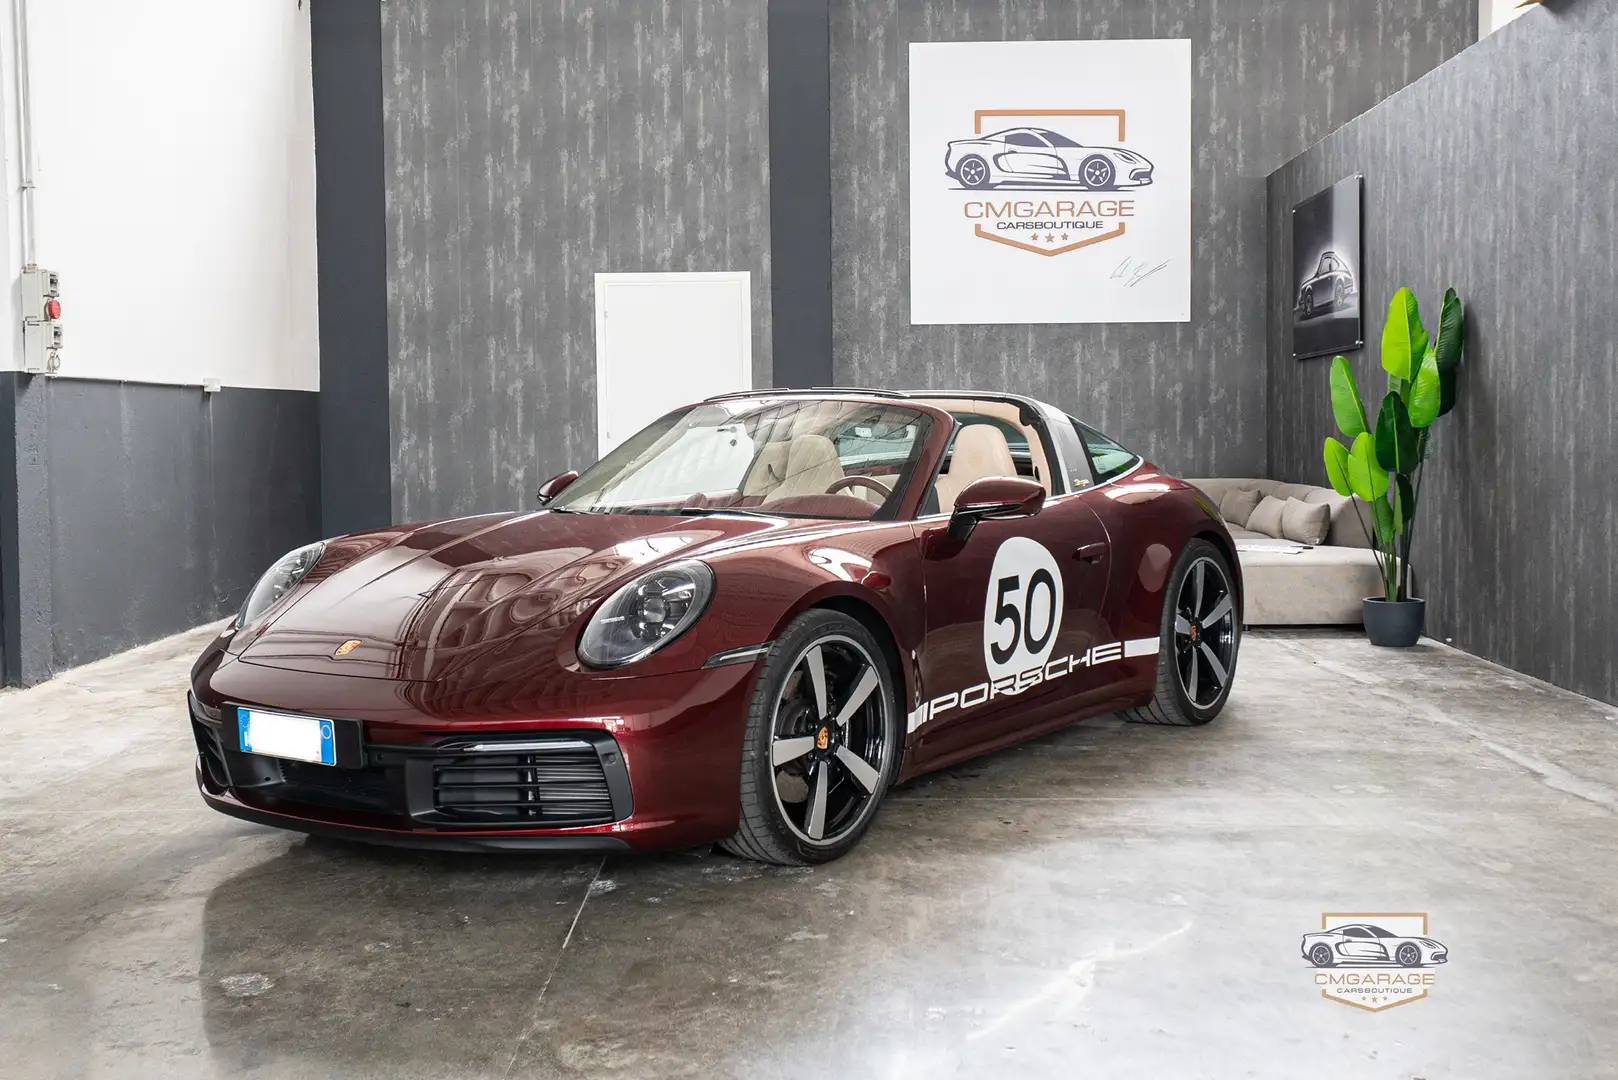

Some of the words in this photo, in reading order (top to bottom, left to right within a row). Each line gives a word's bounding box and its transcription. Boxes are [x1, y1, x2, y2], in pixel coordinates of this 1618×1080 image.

[964, 200, 1134, 218] CMGARAGE
[996, 220, 1104, 231] CARSBOUTIQUE
[990, 568, 1057, 665] 50
[929, 641, 1122, 721] PORSCHE
